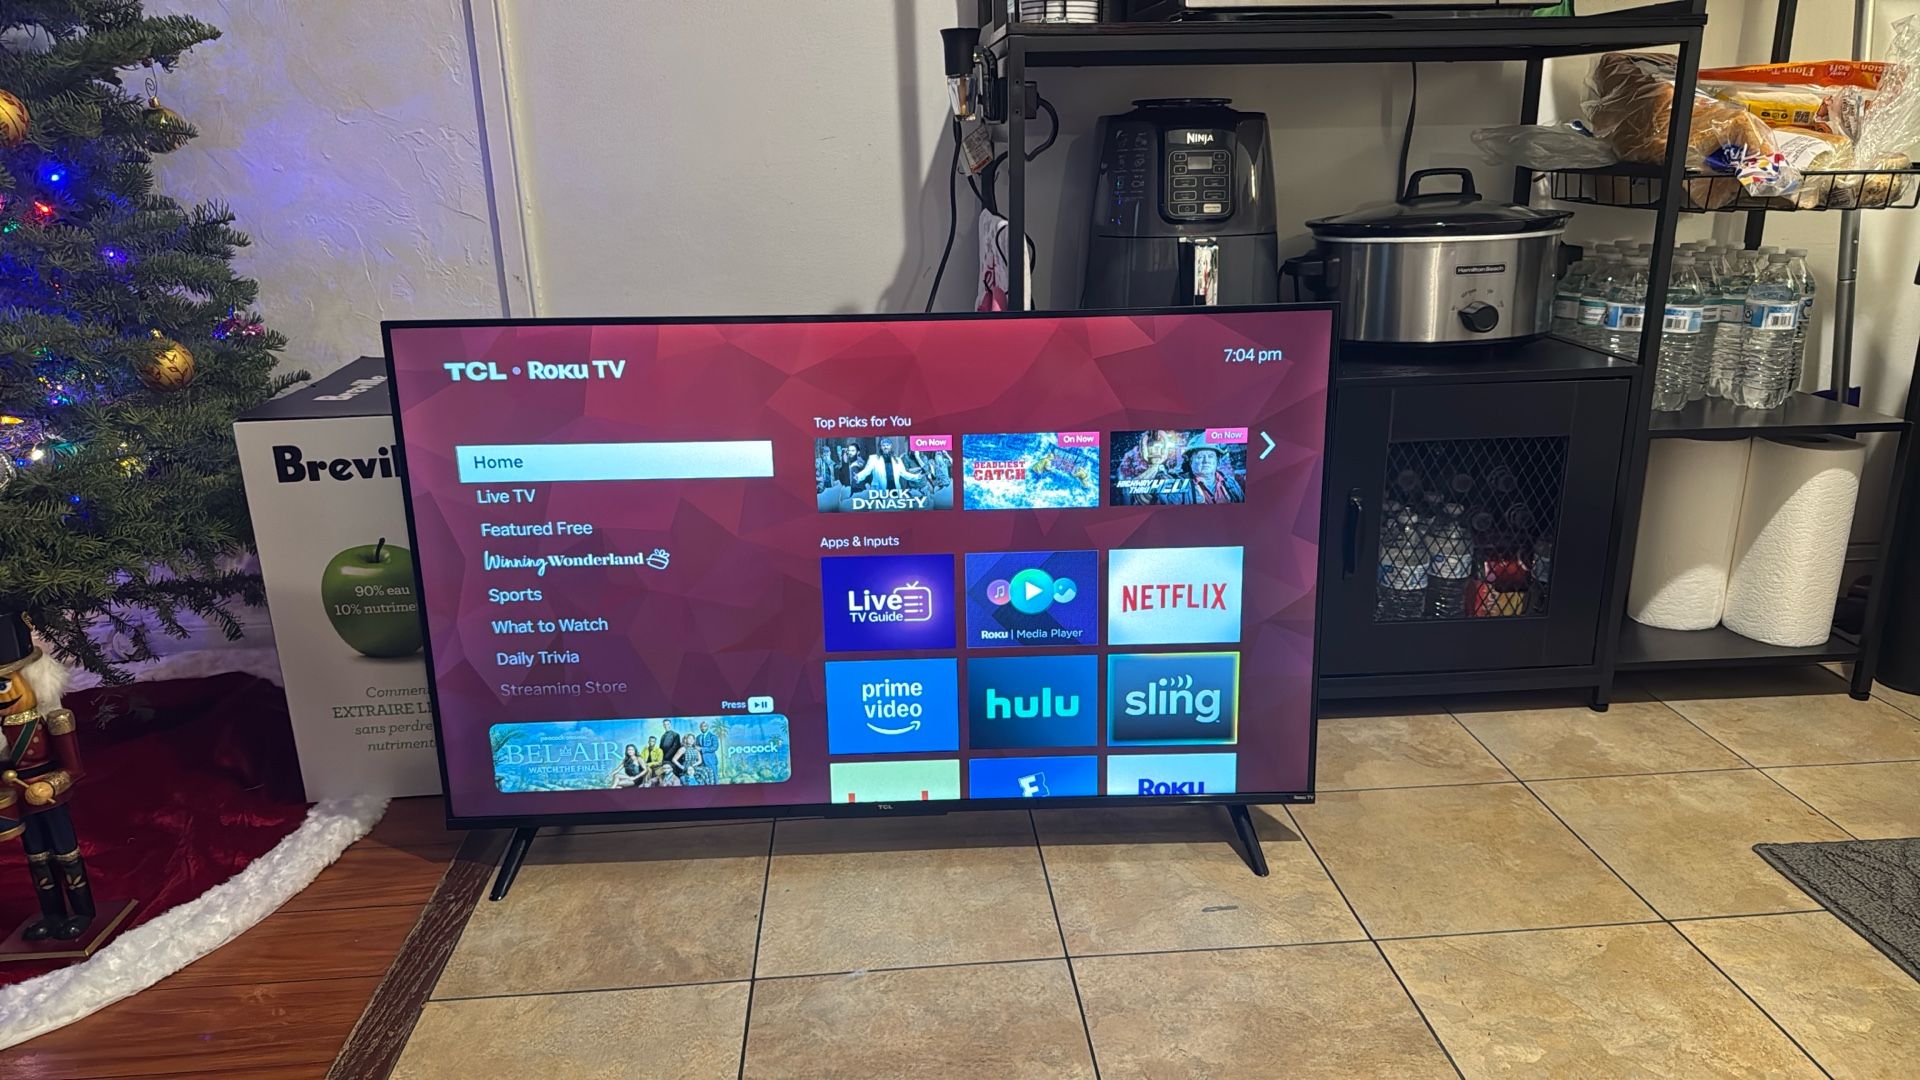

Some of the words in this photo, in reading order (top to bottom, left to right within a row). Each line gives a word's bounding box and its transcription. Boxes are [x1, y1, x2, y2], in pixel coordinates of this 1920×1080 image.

[1186, 132, 1214, 145] NINJA
[1223, 348, 1256, 362] 7:04
[1258, 349, 1283, 365] pm
[443, 361, 508, 382] TCL
[526, 360, 590, 380] Roku
[592, 359, 626, 379] TV
[813, 417, 836, 430] Top
[838, 416, 868, 428] Picks
[870, 415, 888, 428] for
[889, 415, 912, 427] You
[915, 438, 928, 447] On
[928, 438, 947, 447] Now
[1063, 435, 1075, 443] On
[1076, 435, 1095, 443] Now
[1210, 431, 1223, 440] On
[1223, 430, 1243, 439] Now
[473, 455, 524, 469] Home
[973, 460, 1026, 469] DEADLIEST
[973, 468, 1027, 481] CATCH
[476, 489, 510, 504] Live
[512, 488, 536, 503] TV
[868, 488, 911, 500] DUCK
[852, 496, 927, 510] DYNASTY
[480, 521, 553, 537] Featured
[556, 521, 593, 535] Free
[820, 537, 850, 549] Apps
[852, 535, 862, 547] &
[863, 535, 900, 549] Inputs
[483, 550, 548, 577] Winning
[547, 552, 645, 567] Wonderland
[354, 585, 385, 597] 90%
[386, 586, 411, 596] eau
[488, 588, 543, 605] Sports
[1122, 583, 1227, 613] NETFLIX
[848, 589, 903, 611] Live
[334, 603, 362, 616] 10%
[364, 602, 417, 614] nutrime
[849, 612, 867, 623] TV
[868, 611, 904, 622] Guide
[491, 619, 535, 634] What
[537, 619, 556, 633] to
[558, 617, 609, 632] Watch
[981, 630, 1009, 639] Roku
[1016, 629, 1048, 639] Media
[1050, 628, 1084, 639] Player
[496, 651, 535, 667] Daily
[537, 650, 580, 664] Trivia
[365, 686, 429, 698] Commen
[500, 682, 580, 697] Streaming
[585, 681, 628, 694] Store
[862, 678, 923, 702] prime
[721, 700, 747, 709] Press
[986, 687, 1080, 719] hulu
[1125, 677, 1221, 723] sling
[332, 702, 415, 719] EXTRAIRE
[864, 699, 923, 718] video
[354, 725, 386, 735] sans
[388, 719, 433, 736] perdre
[505, 743, 561, 764] BEL
[573, 741, 624, 763] AIR
[728, 742, 778, 758] peacock
[528, 765, 559, 774] WATCH
[559, 765, 576, 773] THE
[577, 764, 606, 772] FINALE
